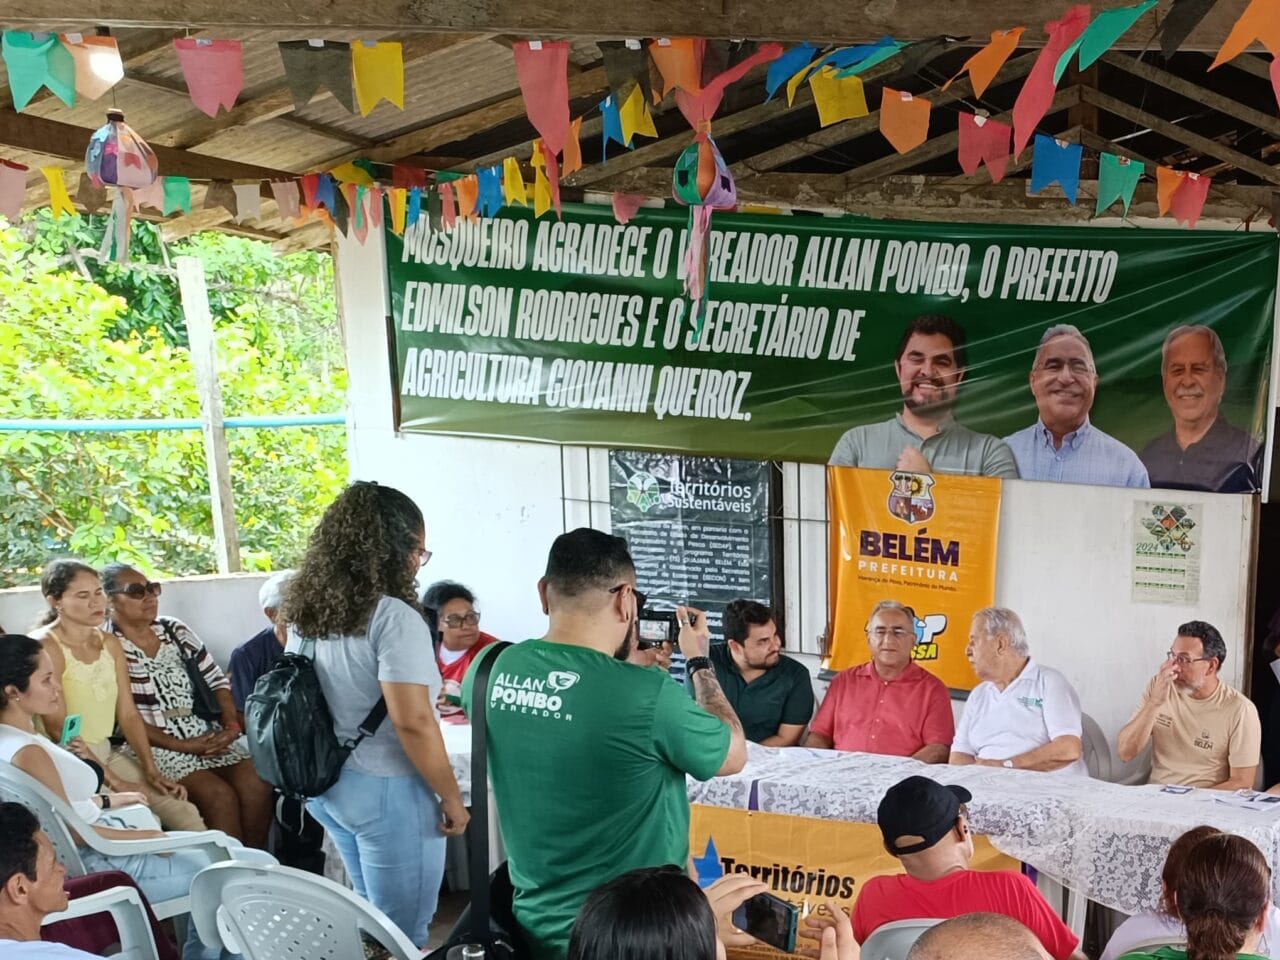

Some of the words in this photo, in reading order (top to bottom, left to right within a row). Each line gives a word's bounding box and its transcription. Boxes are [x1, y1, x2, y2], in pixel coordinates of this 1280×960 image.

[533, 219, 652, 279] AGRADECE
[653, 227, 673, 279] O
[799, 235, 882, 292] ALLAN
[879, 240, 972, 303] POMBO,
[978, 245, 1001, 300] O
[1000, 246, 1119, 303] PREFEITO
[402, 281, 514, 339] EDMILSON
[515, 288, 643, 348] RODRIGUES
[642, 297, 662, 348] E
[663, 298, 683, 350] O
[685, 294, 829, 361] SECRETÁRIO
[829, 309, 866, 362] DE
[402, 348, 543, 406] AGRICULTURA
[545, 358, 654, 414] GIOVANNI
[654, 366, 753, 421] QUEIROZ.
[860, 527, 960, 567] BELÉM
[1136, 542, 1159, 552] 2024
[858, 560, 958, 582] PREFEITURA
[494, 672, 546, 692] ALLAN
[490, 685, 563, 712] POMBO
[490, 701, 573, 722] VEREADOR
